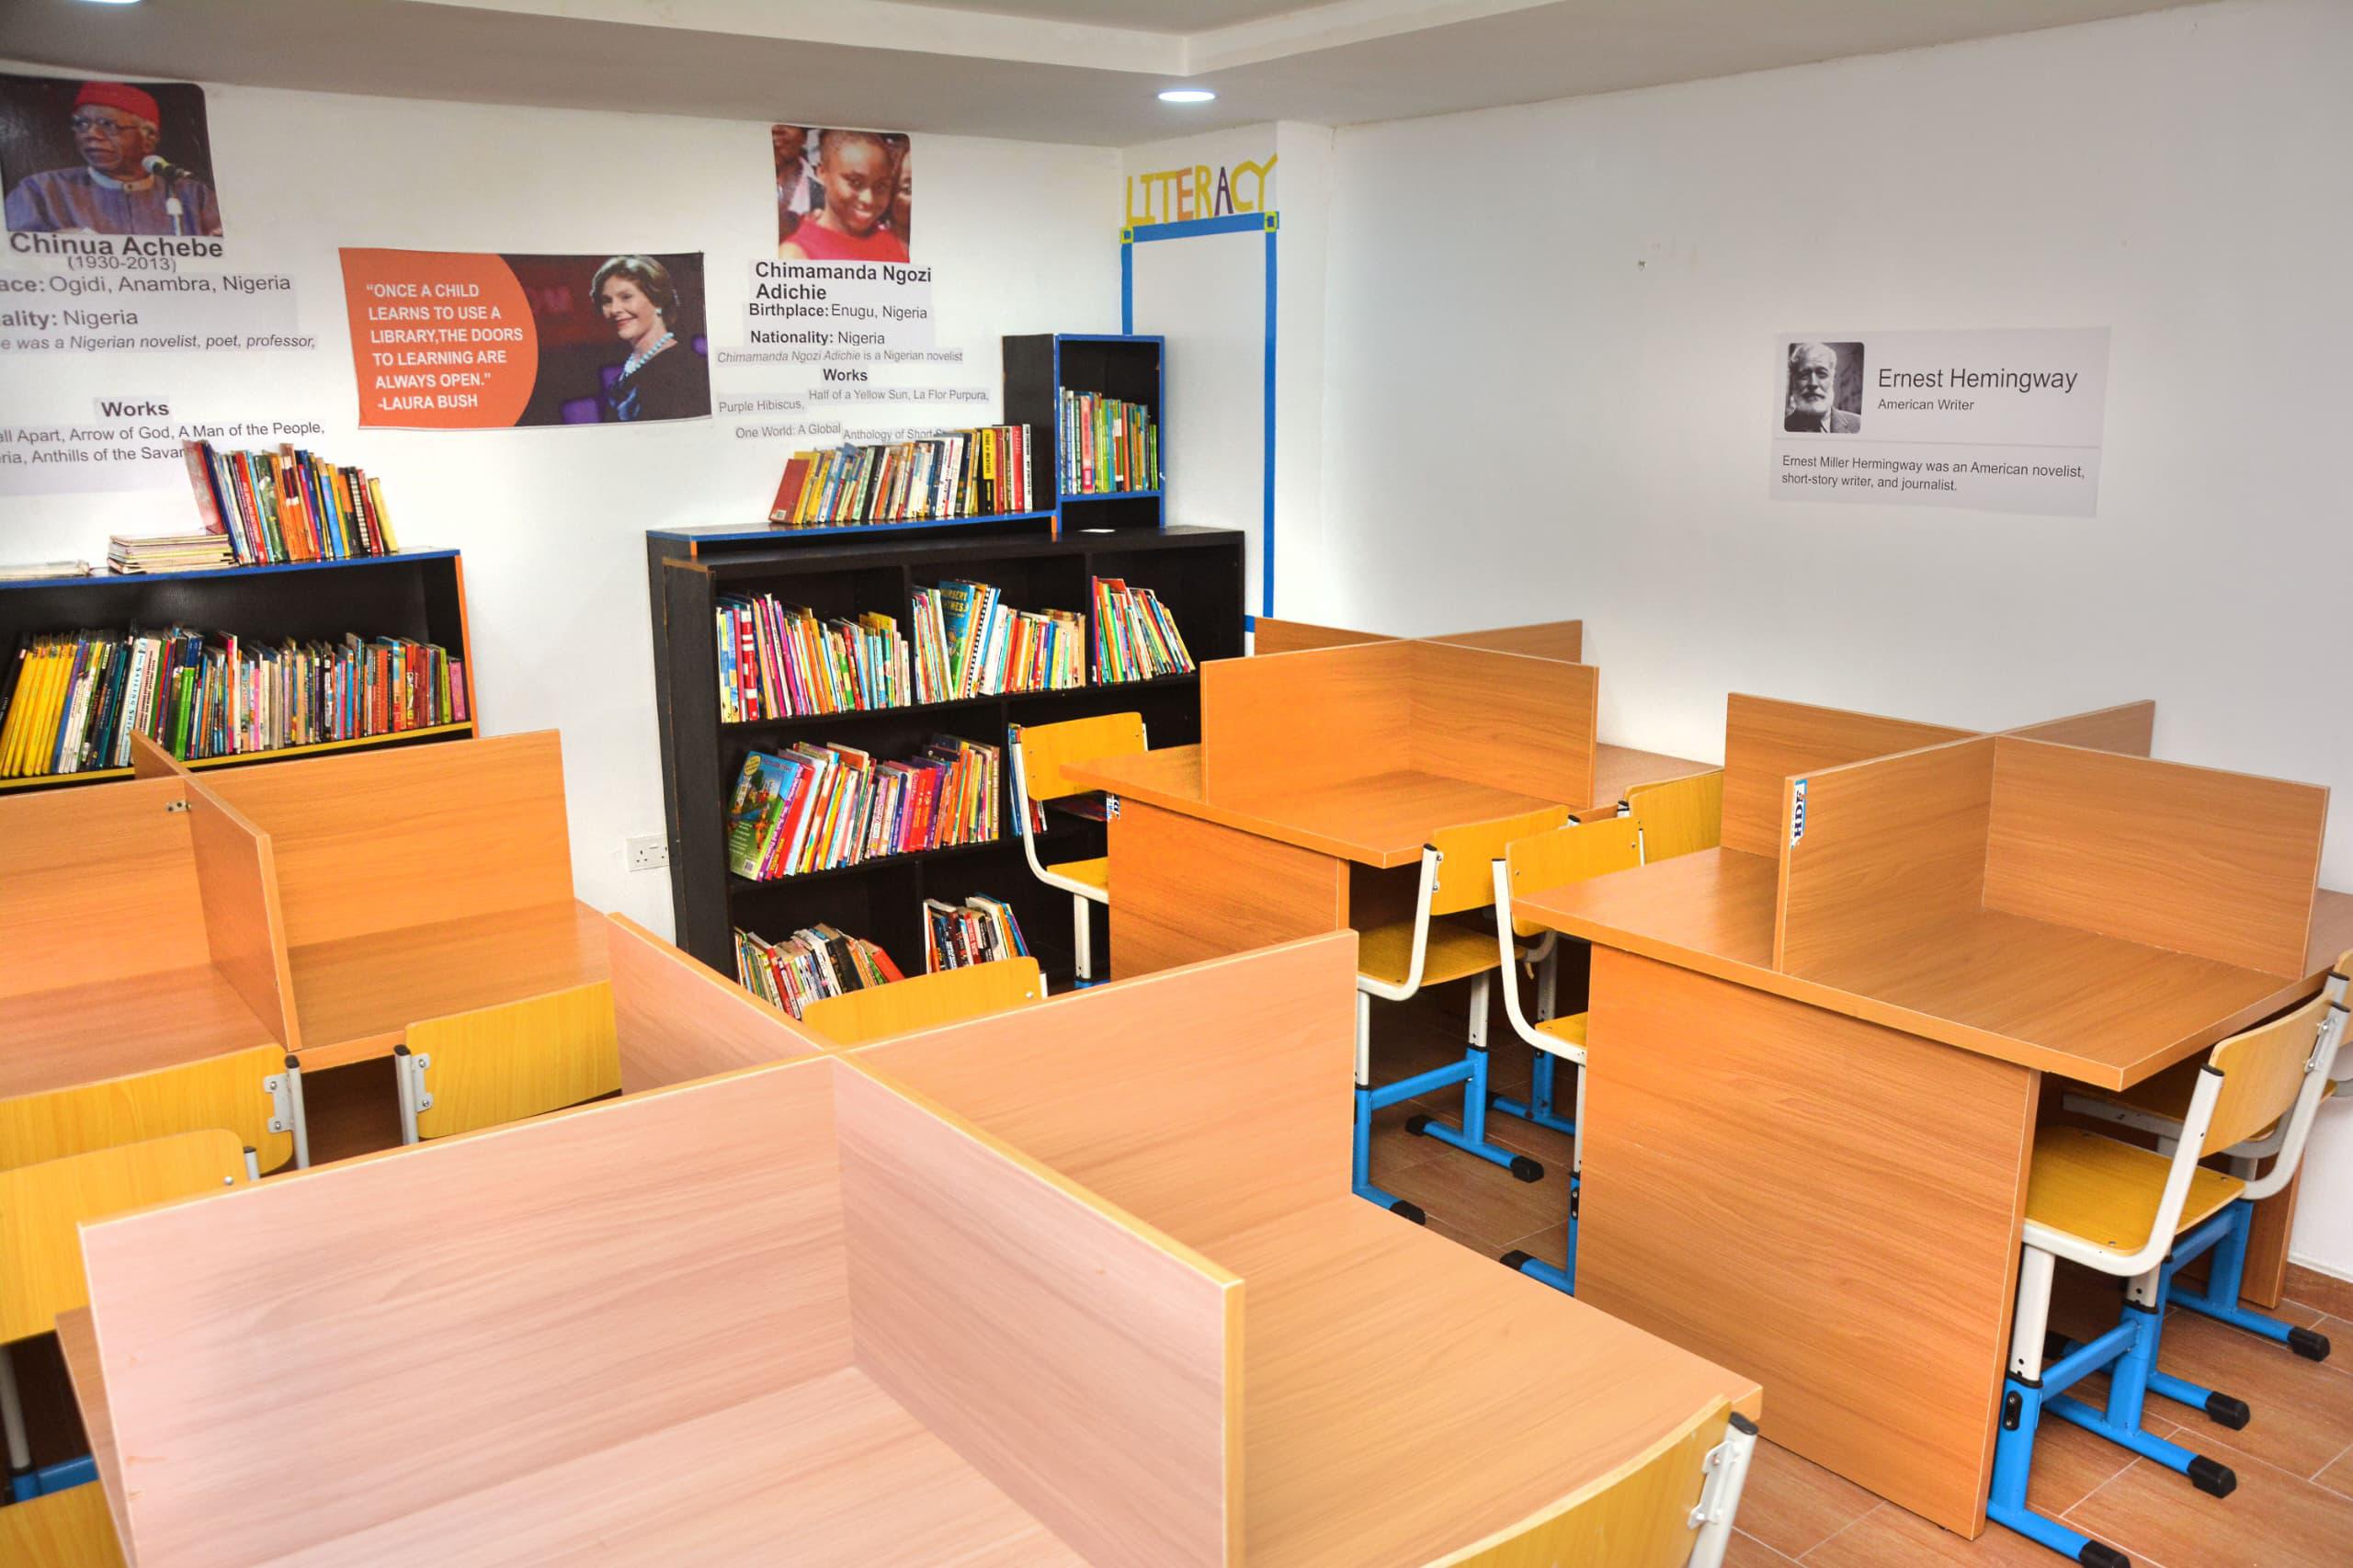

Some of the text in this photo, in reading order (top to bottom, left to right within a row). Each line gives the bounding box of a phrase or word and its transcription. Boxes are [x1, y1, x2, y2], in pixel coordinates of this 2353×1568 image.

[1126, 152, 1279, 226] LITERACY
[10, 233, 223, 257] Chinua Achebe
[67, 256, 176, 273] (1930-2013)
[756, 262, 931, 285] Chimamanda Ngozi
[50, 276, 112, 296] Ogidi,
[119, 276, 216, 293] Anambra,
[223, 275, 290, 294] Nigeria
[421, 285, 432, 297] A
[435, 284, 480, 297] CHILD
[756, 283, 827, 300] Adichie
[2, 309, 138, 330] ality: Nigeria
[369, 307, 501, 321] LEARNS TO USE A
[749, 302, 927, 321] Birthplace: Enugu, Nigeria
[1, 334, 315, 351] e was a Nigerian novelist, poet, professor,
[472, 328, 523, 341] DOORS
[751, 330, 885, 346] Nationality: Nigeria
[372, 350, 506, 367] TO LEARNING ARE
[718, 350, 963, 363] Chimamanda Ngozi Adichie is a Nigerian novelist
[375, 374, 436, 389] ALWAYS
[824, 368, 868, 381] Works
[1879, 368, 2077, 393] Ernest Hemingway
[378, 394, 478, 410] -LAURA BUSH
[809, 389, 989, 402] Half of a Yellow Sun, La Flor Purpura,
[101, 401, 169, 417] Works
[719, 399, 805, 414] Purple Hibiscus,
[1878, 399, 1975, 411] American Writer
[17, 429, 65, 445] Apart,
[70, 427, 115, 441] Arrow
[119, 426, 133, 440] of
[139, 426, 175, 440] God,
[178, 426, 190, 438] A
[193, 425, 224, 437] Man
[229, 424, 243, 437] of
[246, 424, 268, 436] the
[273, 422, 324, 437] People,
[735, 423, 841, 438] One World: A Global
[844, 429, 892, 441] Anthology
[895, 428, 905, 439] of
[907, 428, 933, 439] Short
[0, 450, 28, 464] ria,
[31, 449, 89, 463] Anthills
[94, 448, 108, 461] of
[112, 449, 136, 460] the
[1782, 455, 2085, 479] Ernest Miller Hermingway was an American novelist,
[1782, 473, 1957, 491] short-story writer, and journalist.
